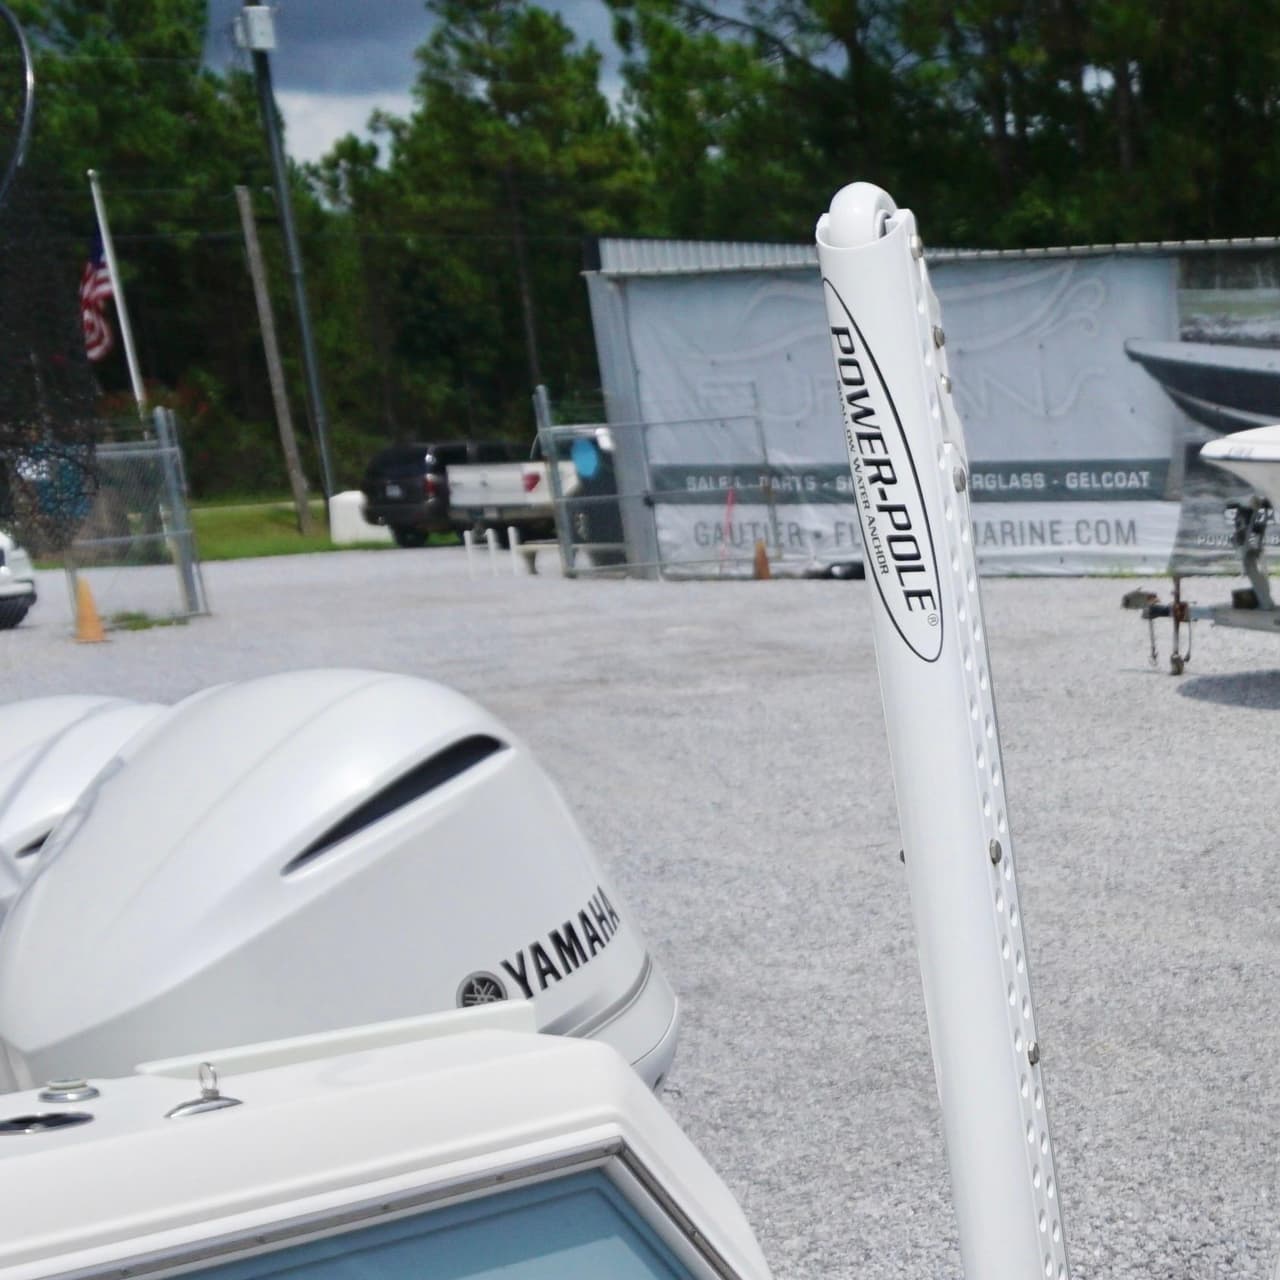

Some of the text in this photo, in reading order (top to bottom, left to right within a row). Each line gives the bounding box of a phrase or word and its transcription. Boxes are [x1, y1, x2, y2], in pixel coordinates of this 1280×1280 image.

[831, 326, 937, 612] POWER-POLE
[853, 457, 870, 509] WATER
[865, 514, 889, 575] ANCHOR
[1065, 471, 1150, 490] GELCOAT
[692, 520, 803, 549] GAUTIER
[500, 884, 620, 1000] YAMAHA
